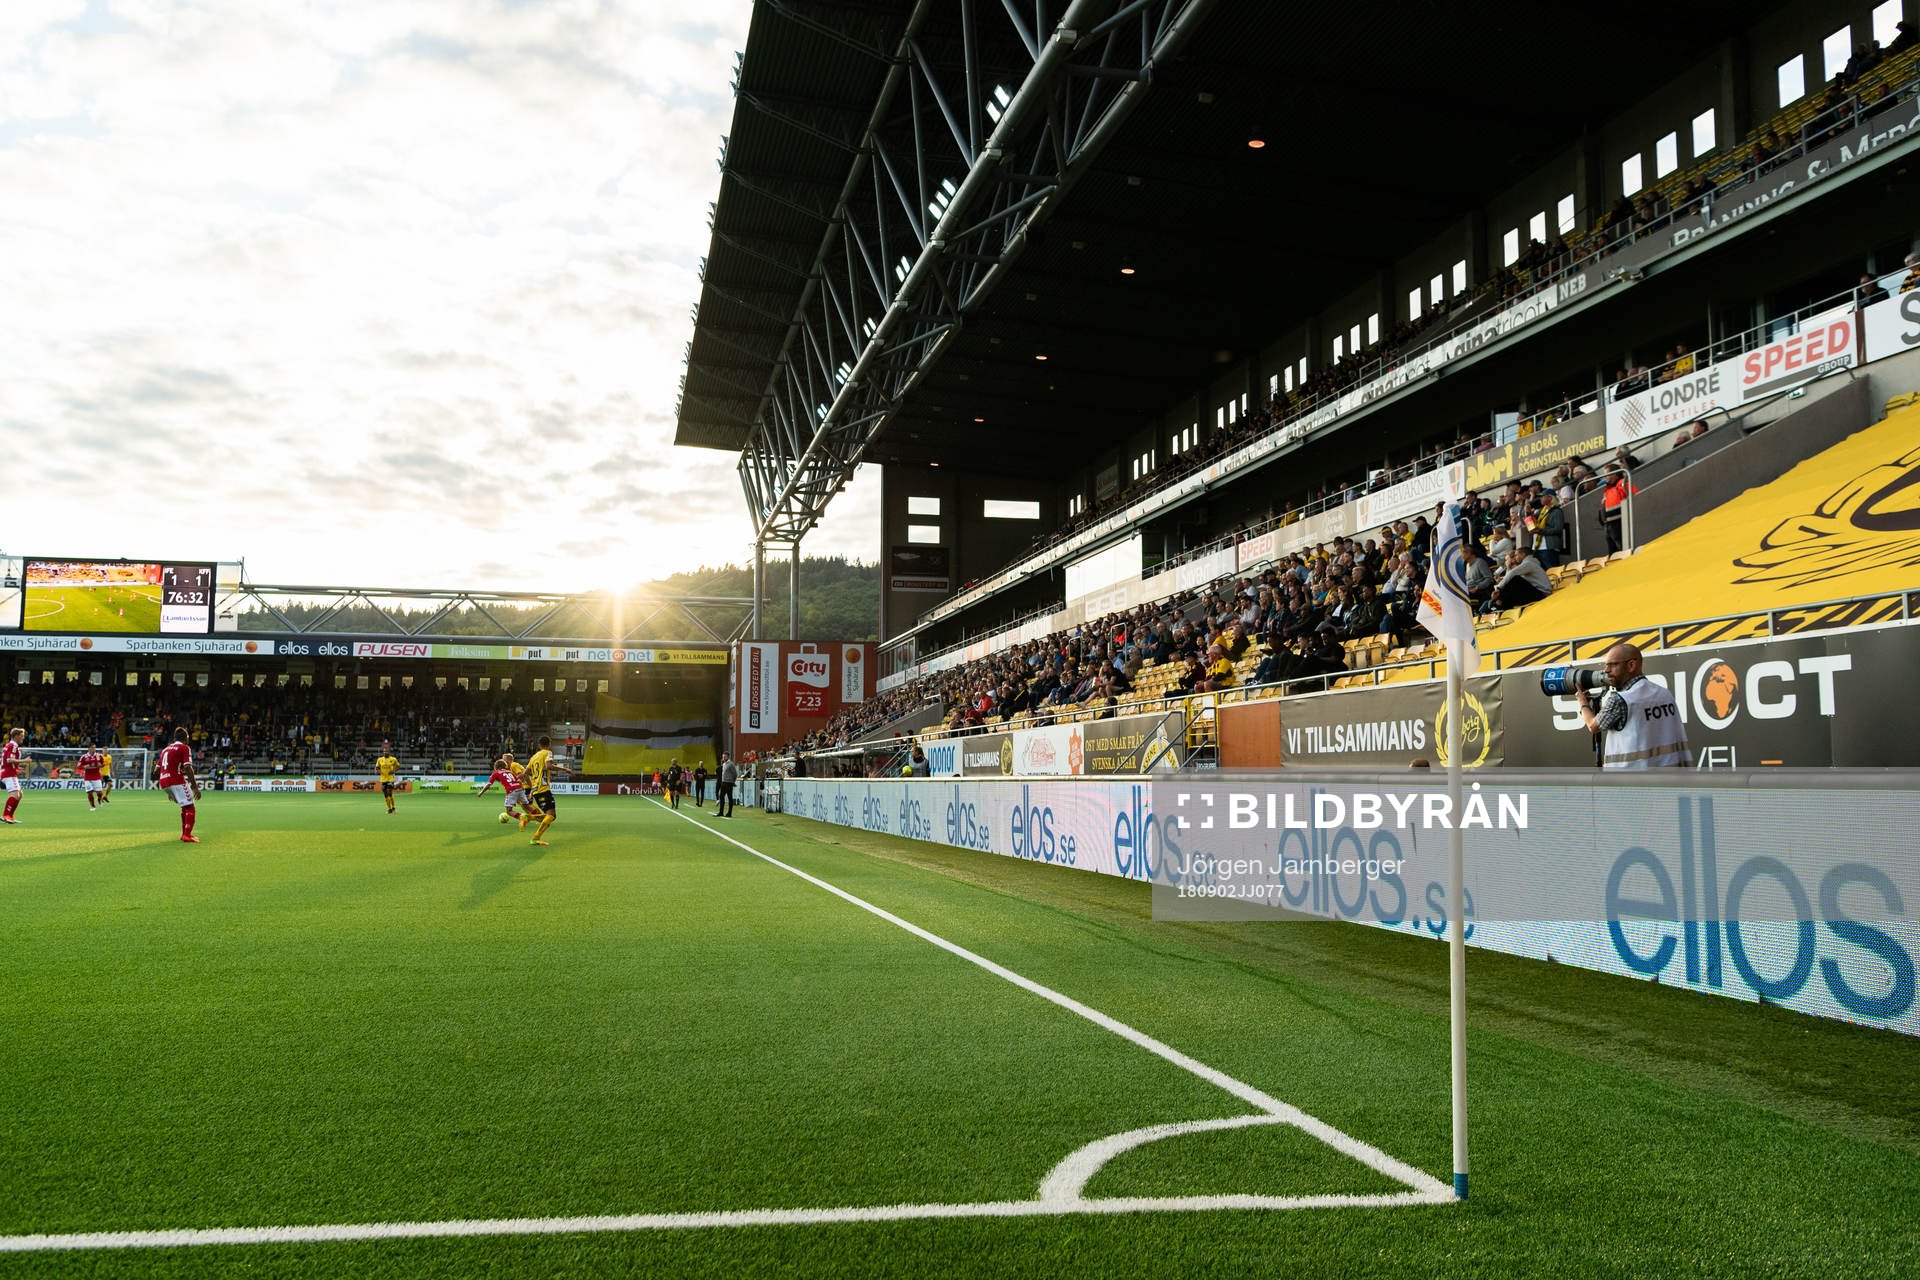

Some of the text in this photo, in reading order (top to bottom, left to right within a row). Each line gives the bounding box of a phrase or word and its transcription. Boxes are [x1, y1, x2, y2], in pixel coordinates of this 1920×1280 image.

[1558, 273, 1587, 300] NEB
[1743, 320, 1851, 385] SPEED
[1817, 355, 1851, 375] GROUP
[1650, 367, 1721, 415] LONDRÉ
[1656, 399, 1717, 426] TEXTILES
[1518, 435, 1605, 474] RÖRINSTALLATIONER
[1519, 433, 1558, 459] AB BORÅS
[172, 575, 177, 586] 1
[196, 576, 202, 587] 1
[168, 592, 204, 604] 76:32
[27, 637, 77, 649] Sjuhärad
[126, 640, 243, 653] Sparbanken Sjuhärad
[279, 641, 348, 656] ellos ellos
[357, 643, 428, 656] PULSEN
[751, 665, 760, 708] BOGSTEDT
[795, 696, 822, 707] 7-23
[1096, 738, 1109, 751] MED
[1288, 718, 1426, 754] VI TILLSAMMANS
[162, 752, 169, 770] 4
[928, 745, 955, 776] uponor
[970, 751, 1000, 768] TILLSAMMANS
[1092, 757, 1115, 770] SVENSKA
[862, 784, 889, 832] ellos.se
[899, 784, 931, 840] ellos.se
[946, 784, 990, 850] ellos.se
[1011, 784, 1076, 865] ellos.se
[1114, 785, 1217, 888] ellos.se
[1605, 795, 1916, 1020] ellos
